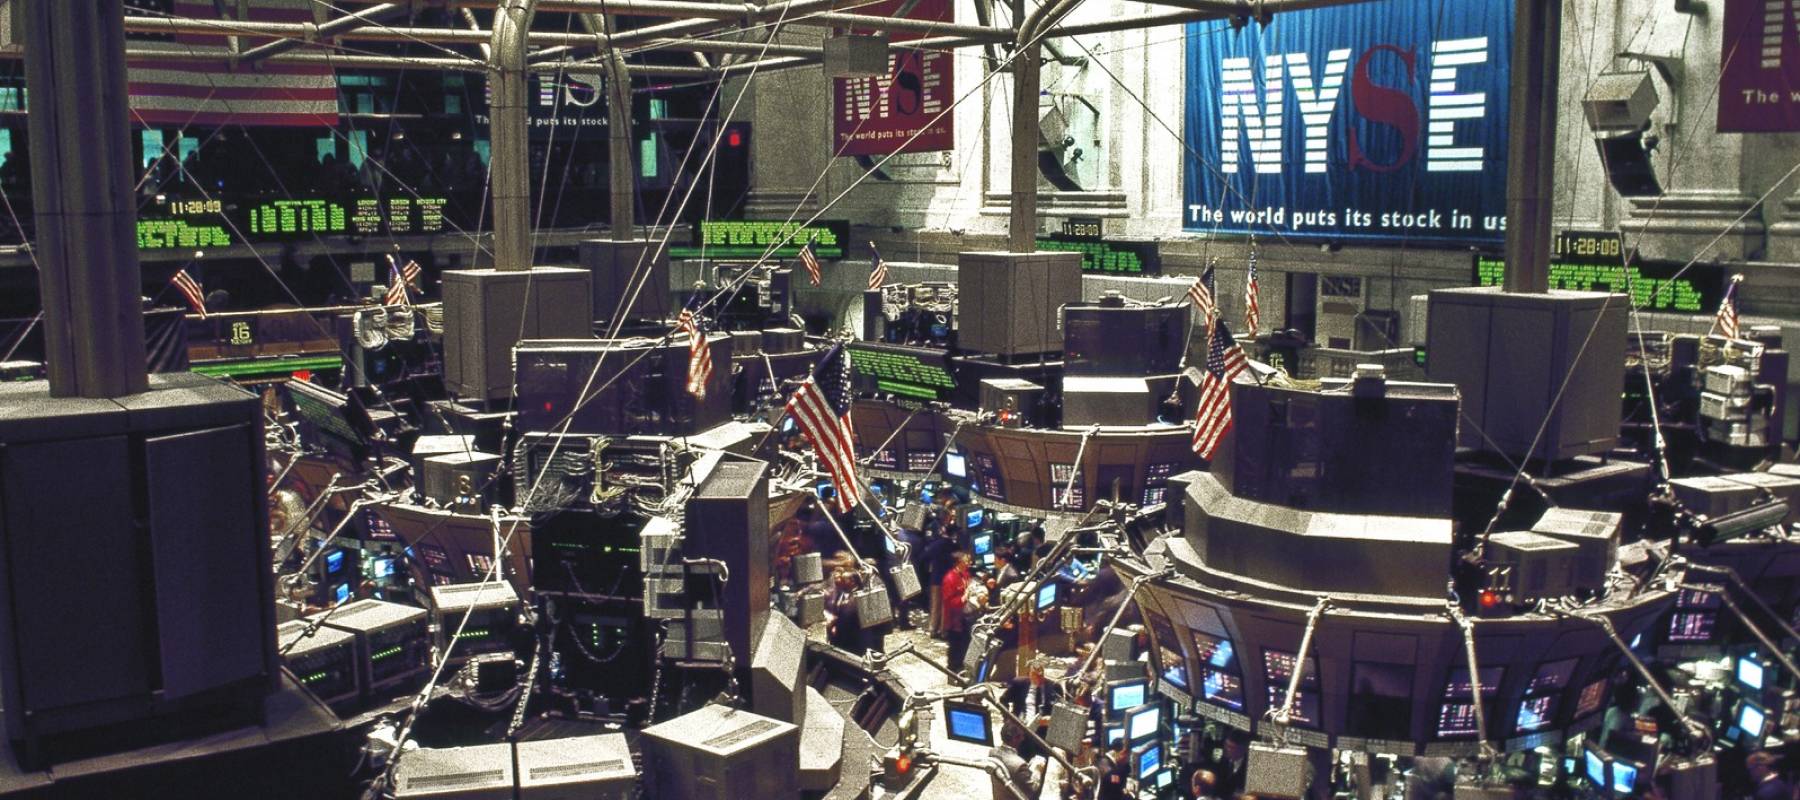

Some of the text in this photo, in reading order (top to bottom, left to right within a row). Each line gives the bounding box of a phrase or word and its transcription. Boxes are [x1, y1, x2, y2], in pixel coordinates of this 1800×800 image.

[845, 49, 941, 121] NYSE
[1741, 88, 1780, 104] The
[1221, 36, 1489, 174] NYSE
[475, 115, 489, 124] Th
[536, 117, 560, 127] puts
[563, 115, 577, 125] its
[581, 115, 608, 126] stock
[856, 130, 876, 140] world
[878, 130, 894, 142] puts
[1188, 204, 1223, 223] The
[1230, 206, 1285, 225] world
[1292, 208, 1337, 230] puts
[1345, 208, 1372, 227] its
[1381, 210, 1442, 230] stock
[1451, 209, 1473, 229] in
[232, 327, 250, 340] 16
